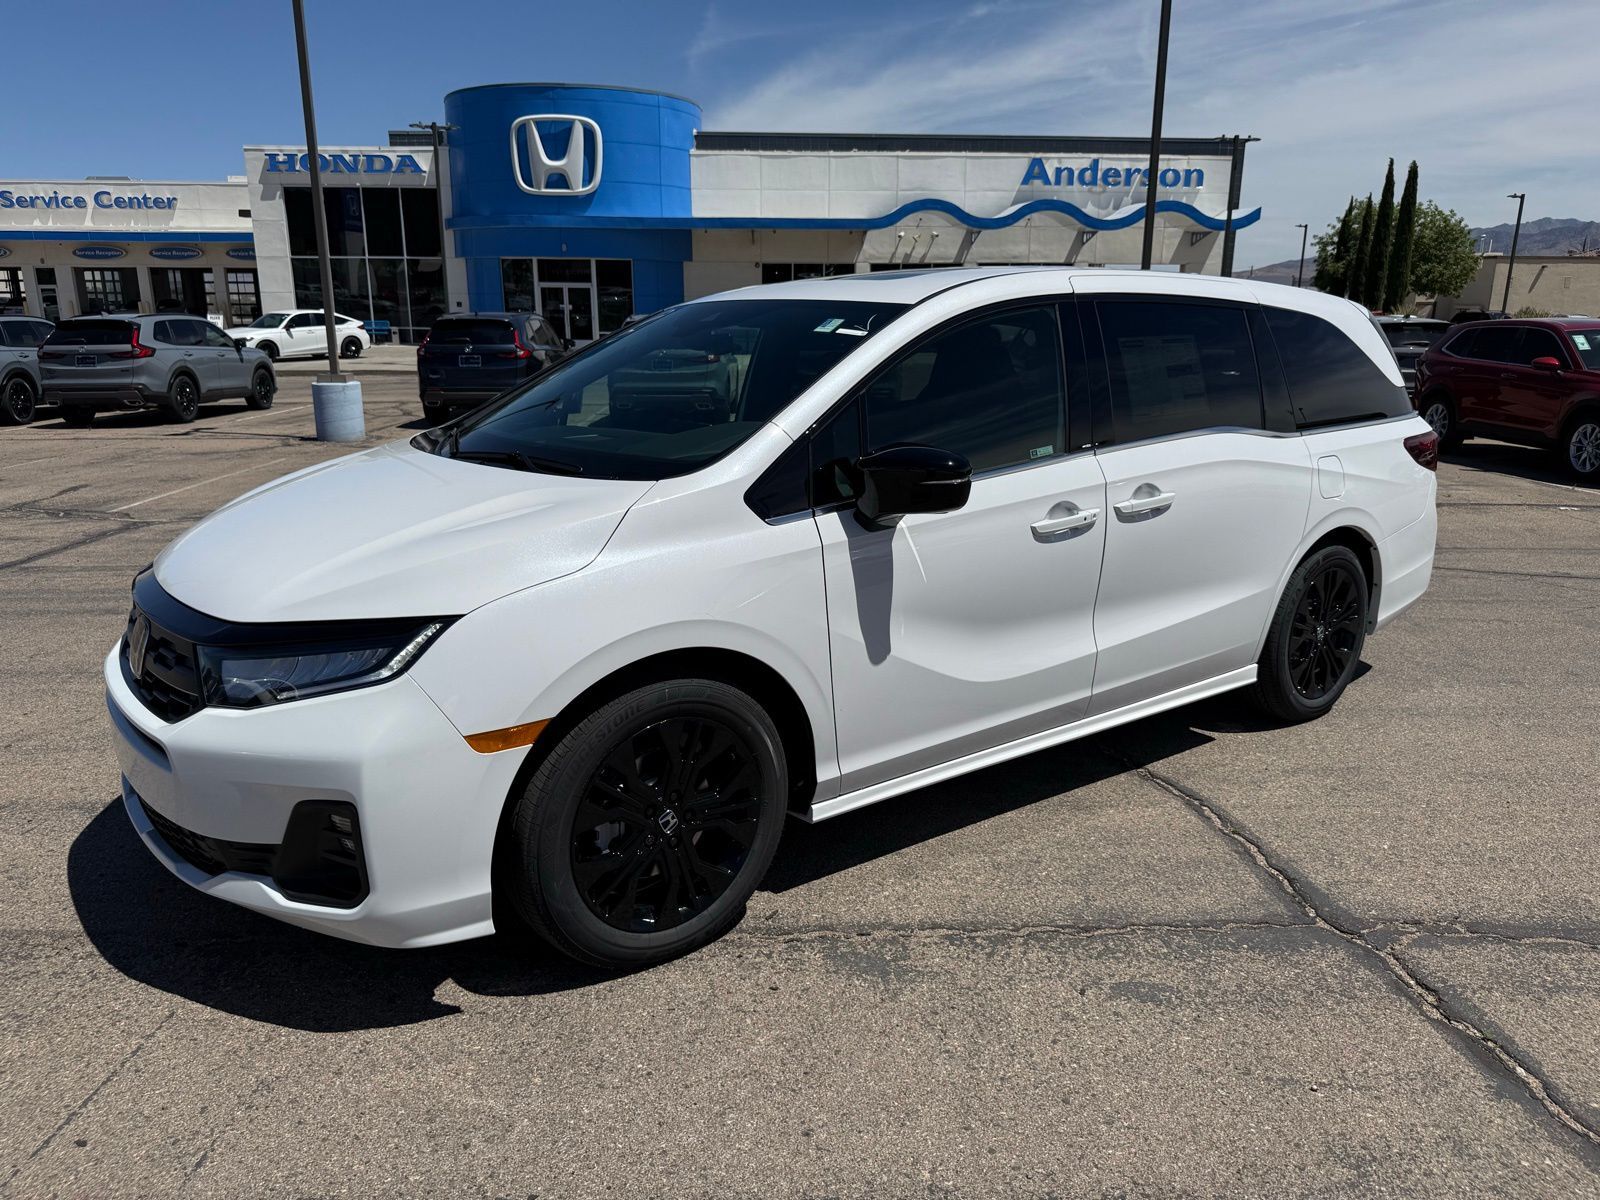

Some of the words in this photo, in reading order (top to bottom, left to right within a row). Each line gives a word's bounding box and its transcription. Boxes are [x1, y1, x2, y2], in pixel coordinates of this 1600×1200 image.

[264, 152, 427, 174] HONDA
[1020, 157, 1205, 188] Anderson
[0, 190, 87, 209] Service
[94, 190, 178, 209] Center
[76, 249, 96, 257] Service
[152, 249, 172, 258] Service
